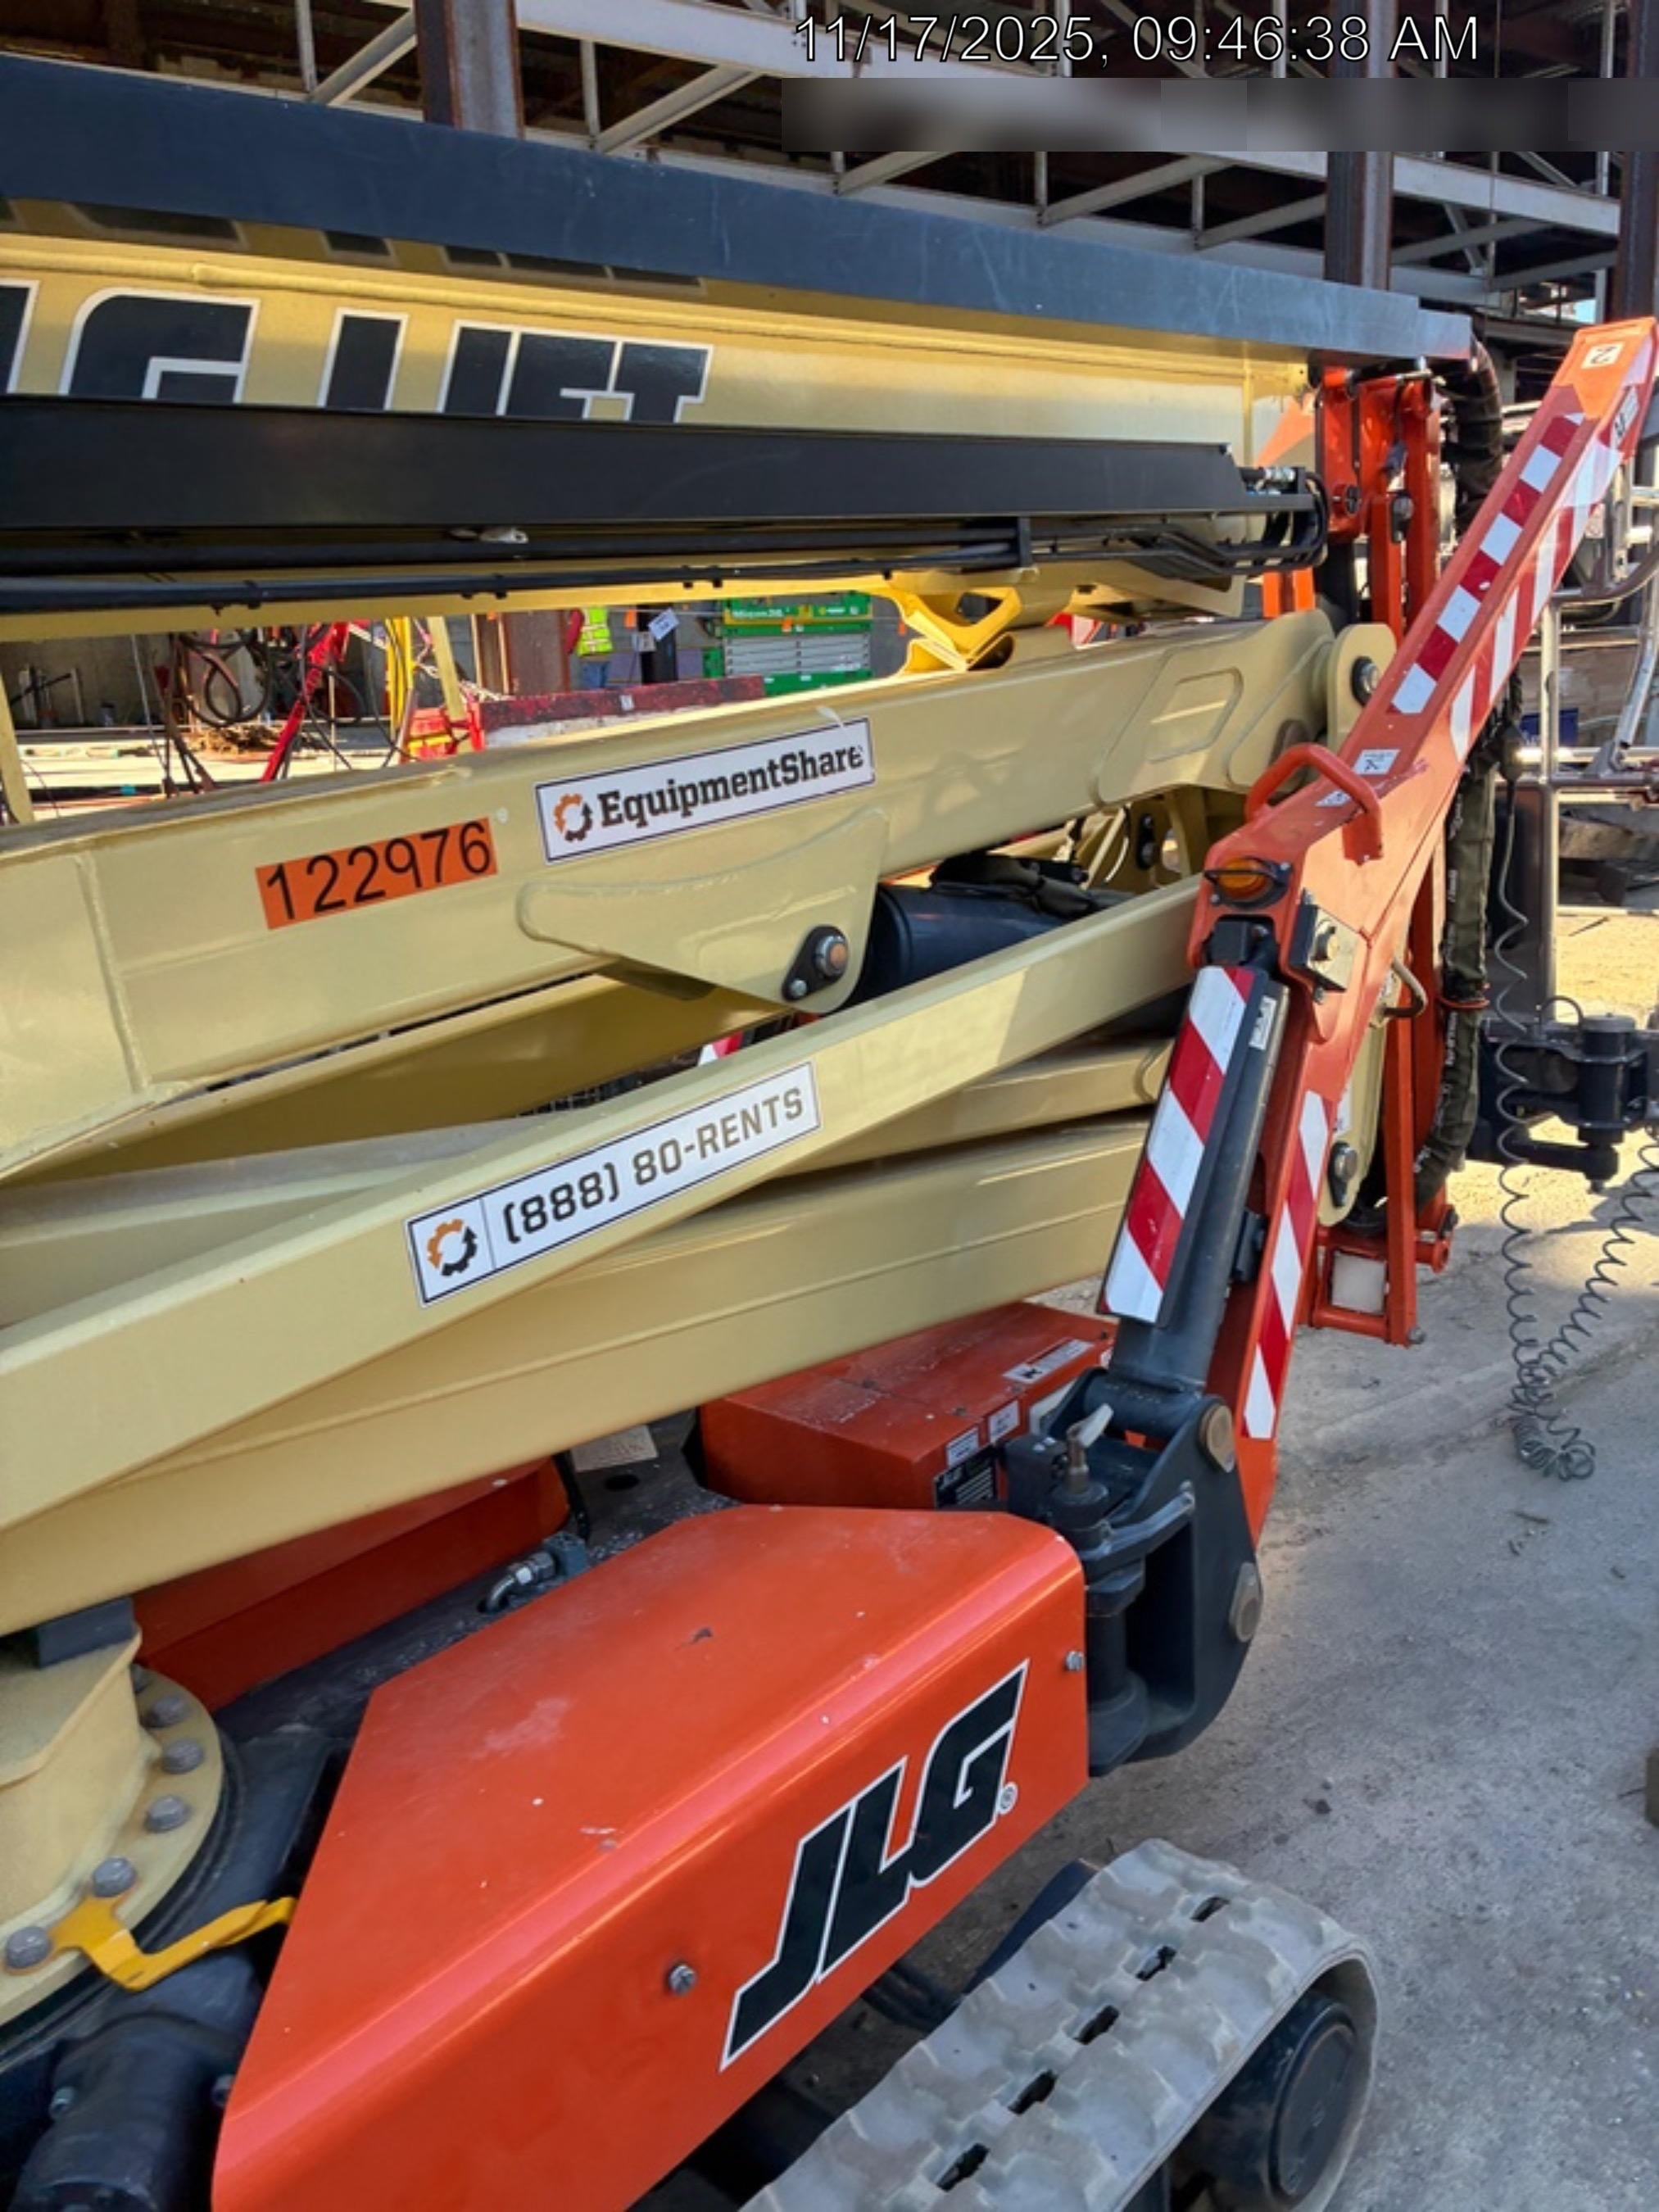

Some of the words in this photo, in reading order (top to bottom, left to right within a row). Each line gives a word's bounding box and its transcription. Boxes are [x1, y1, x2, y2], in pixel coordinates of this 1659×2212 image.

[597, 744, 864, 830] EquipmentShare
[267, 821, 491, 919] 122976
[503, 1163, 619, 1244] (888)
[632, 1087, 804, 1185] 80-RENTS
